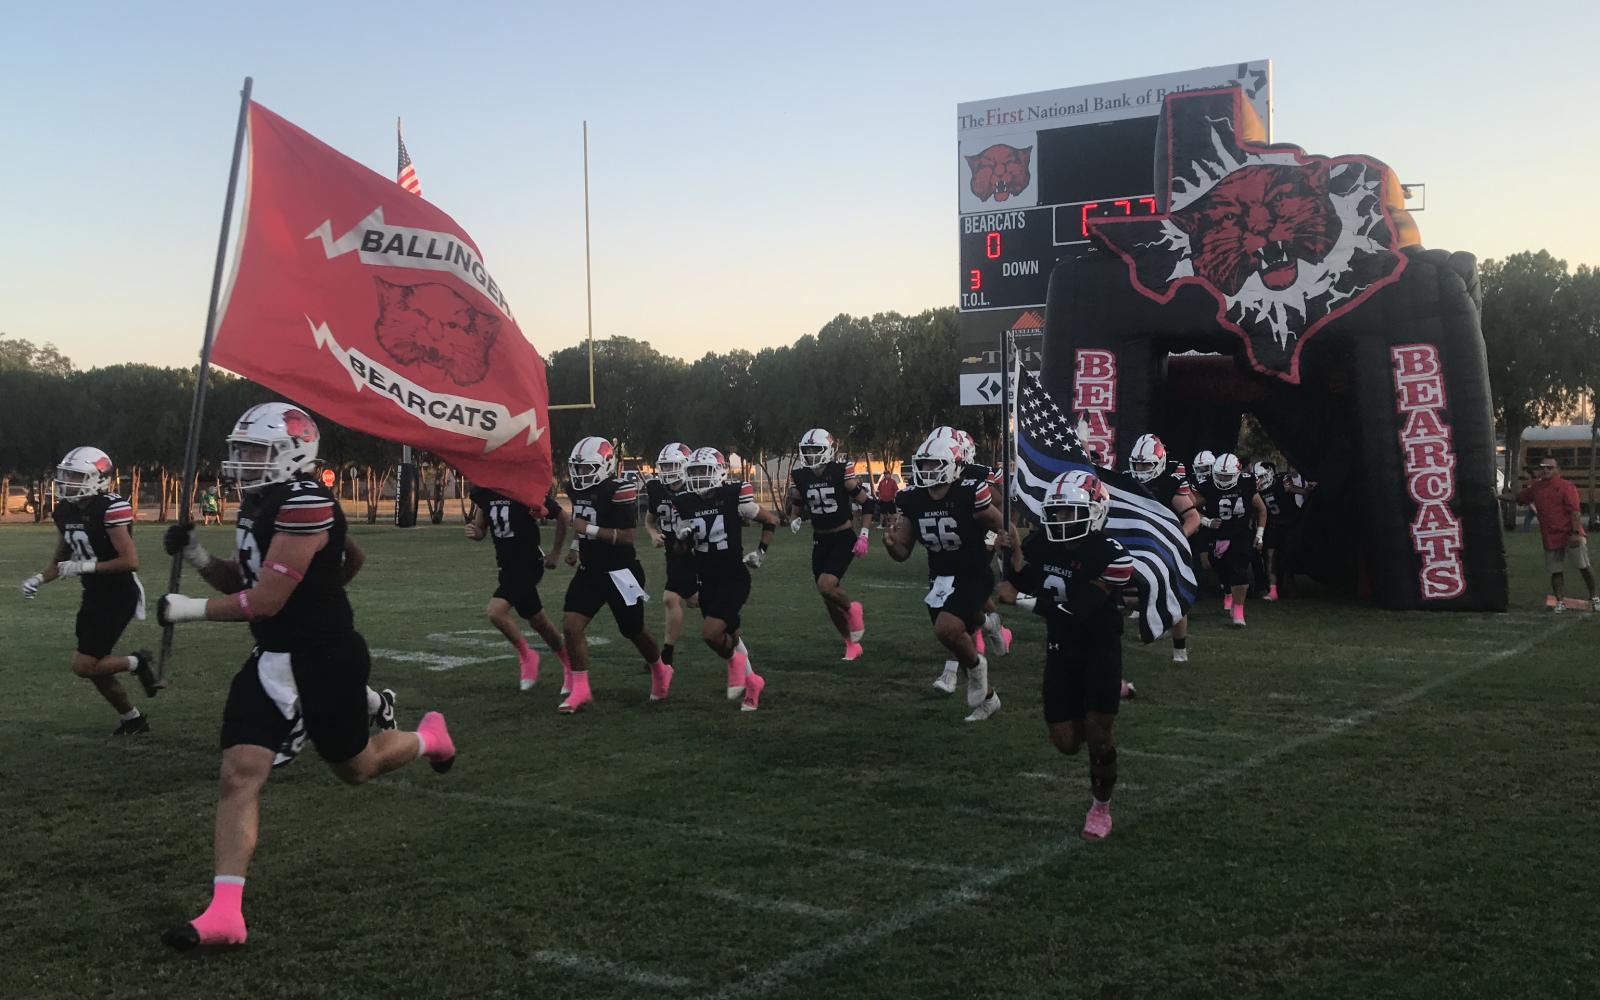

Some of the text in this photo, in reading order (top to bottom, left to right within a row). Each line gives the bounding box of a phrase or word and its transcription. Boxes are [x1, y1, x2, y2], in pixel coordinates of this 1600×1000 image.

[958, 114, 985, 129] The
[986, 107, 1024, 126] First
[1028, 101, 1089, 121] National
[1094, 93, 1132, 112] Bank
[1136, 89, 1153, 105] of
[964, 211, 1026, 234] BEARCATS
[986, 232, 1002, 260] 0
[970, 269, 982, 291] 3
[1002, 260, 1039, 277] DOWN
[962, 293, 990, 307] T.O.L.
[350, 353, 498, 432] BEARCATS
[1391, 344, 1467, 600] BEARCATS
[806, 487, 838, 515] 25
[1218, 496, 1246, 521] 64
[489, 505, 515, 538] 11
[918, 516, 962, 553] 56
[1042, 563, 1073, 578] BEARCATS
